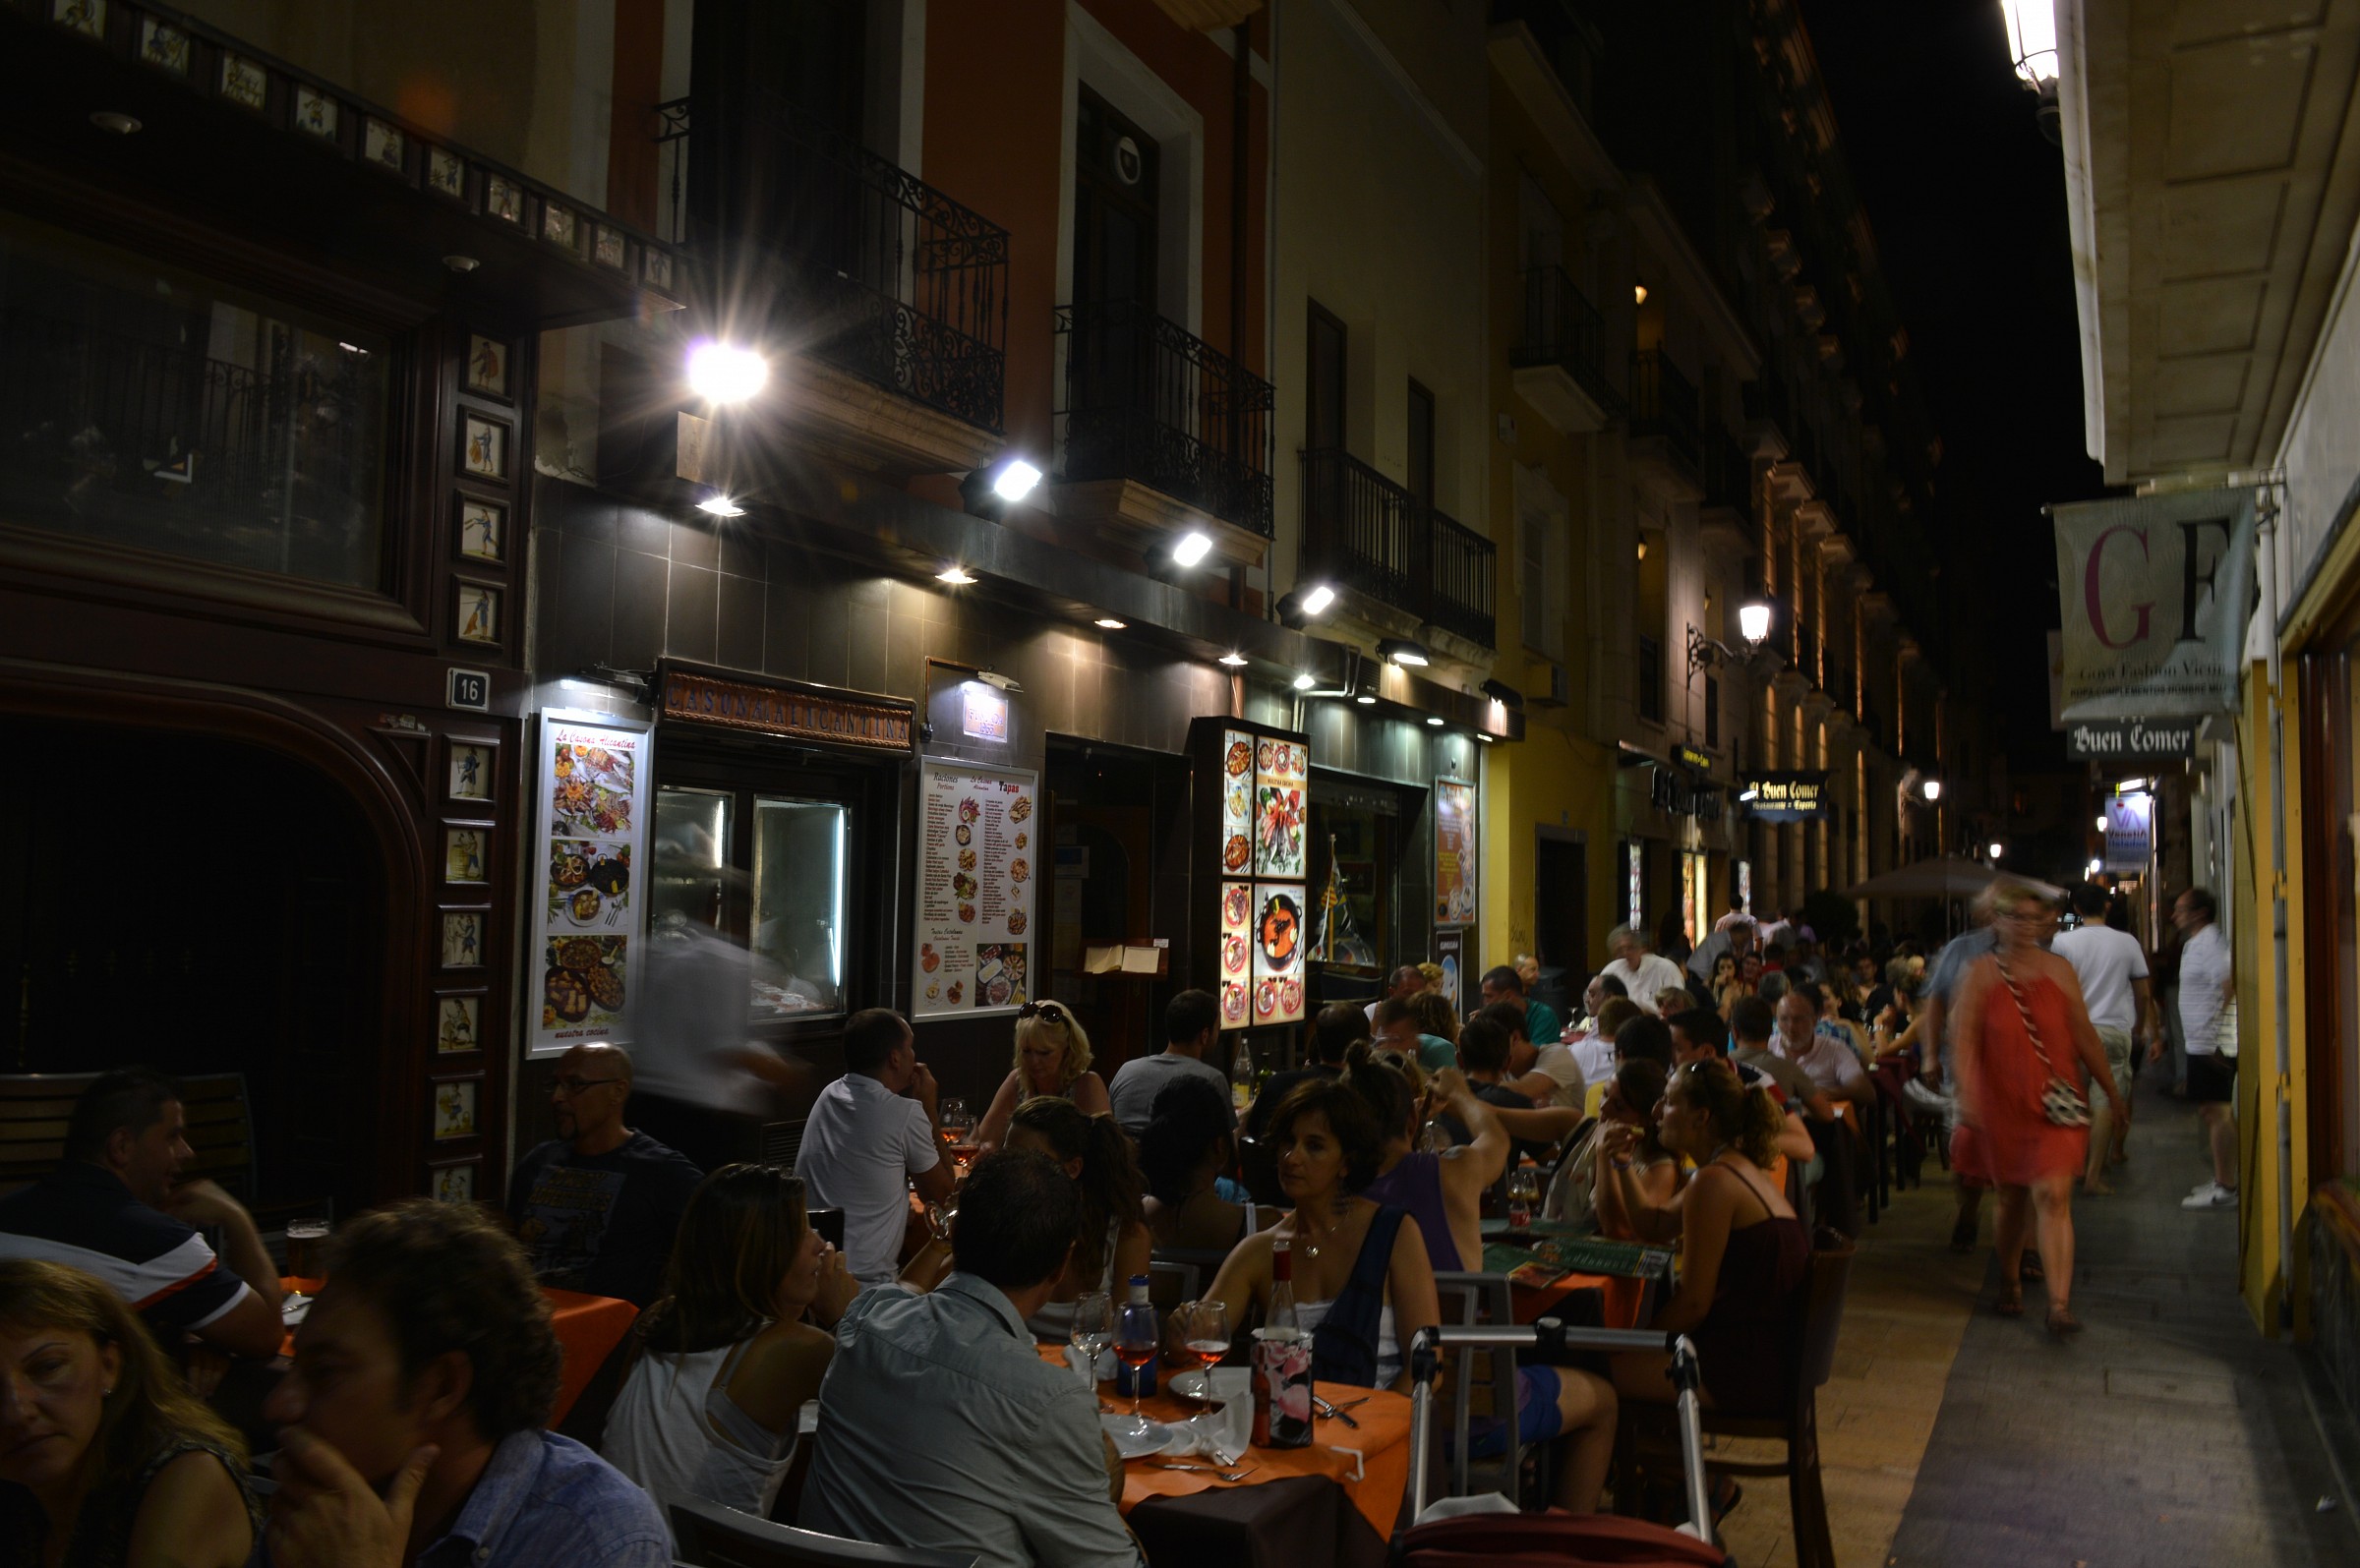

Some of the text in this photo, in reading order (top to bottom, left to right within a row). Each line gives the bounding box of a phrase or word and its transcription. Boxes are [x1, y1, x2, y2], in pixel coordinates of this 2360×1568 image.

[461, 678, 479, 701] 16
[667, 682, 908, 740] CASONA ALICANTINA
[2074, 724, 2190, 752] Buen Comer
[933, 772, 959, 784] Raciones
[998, 781, 1020, 794] Tapas
[1762, 781, 1787, 800] Buen
[1789, 780, 1819, 800] Comer
